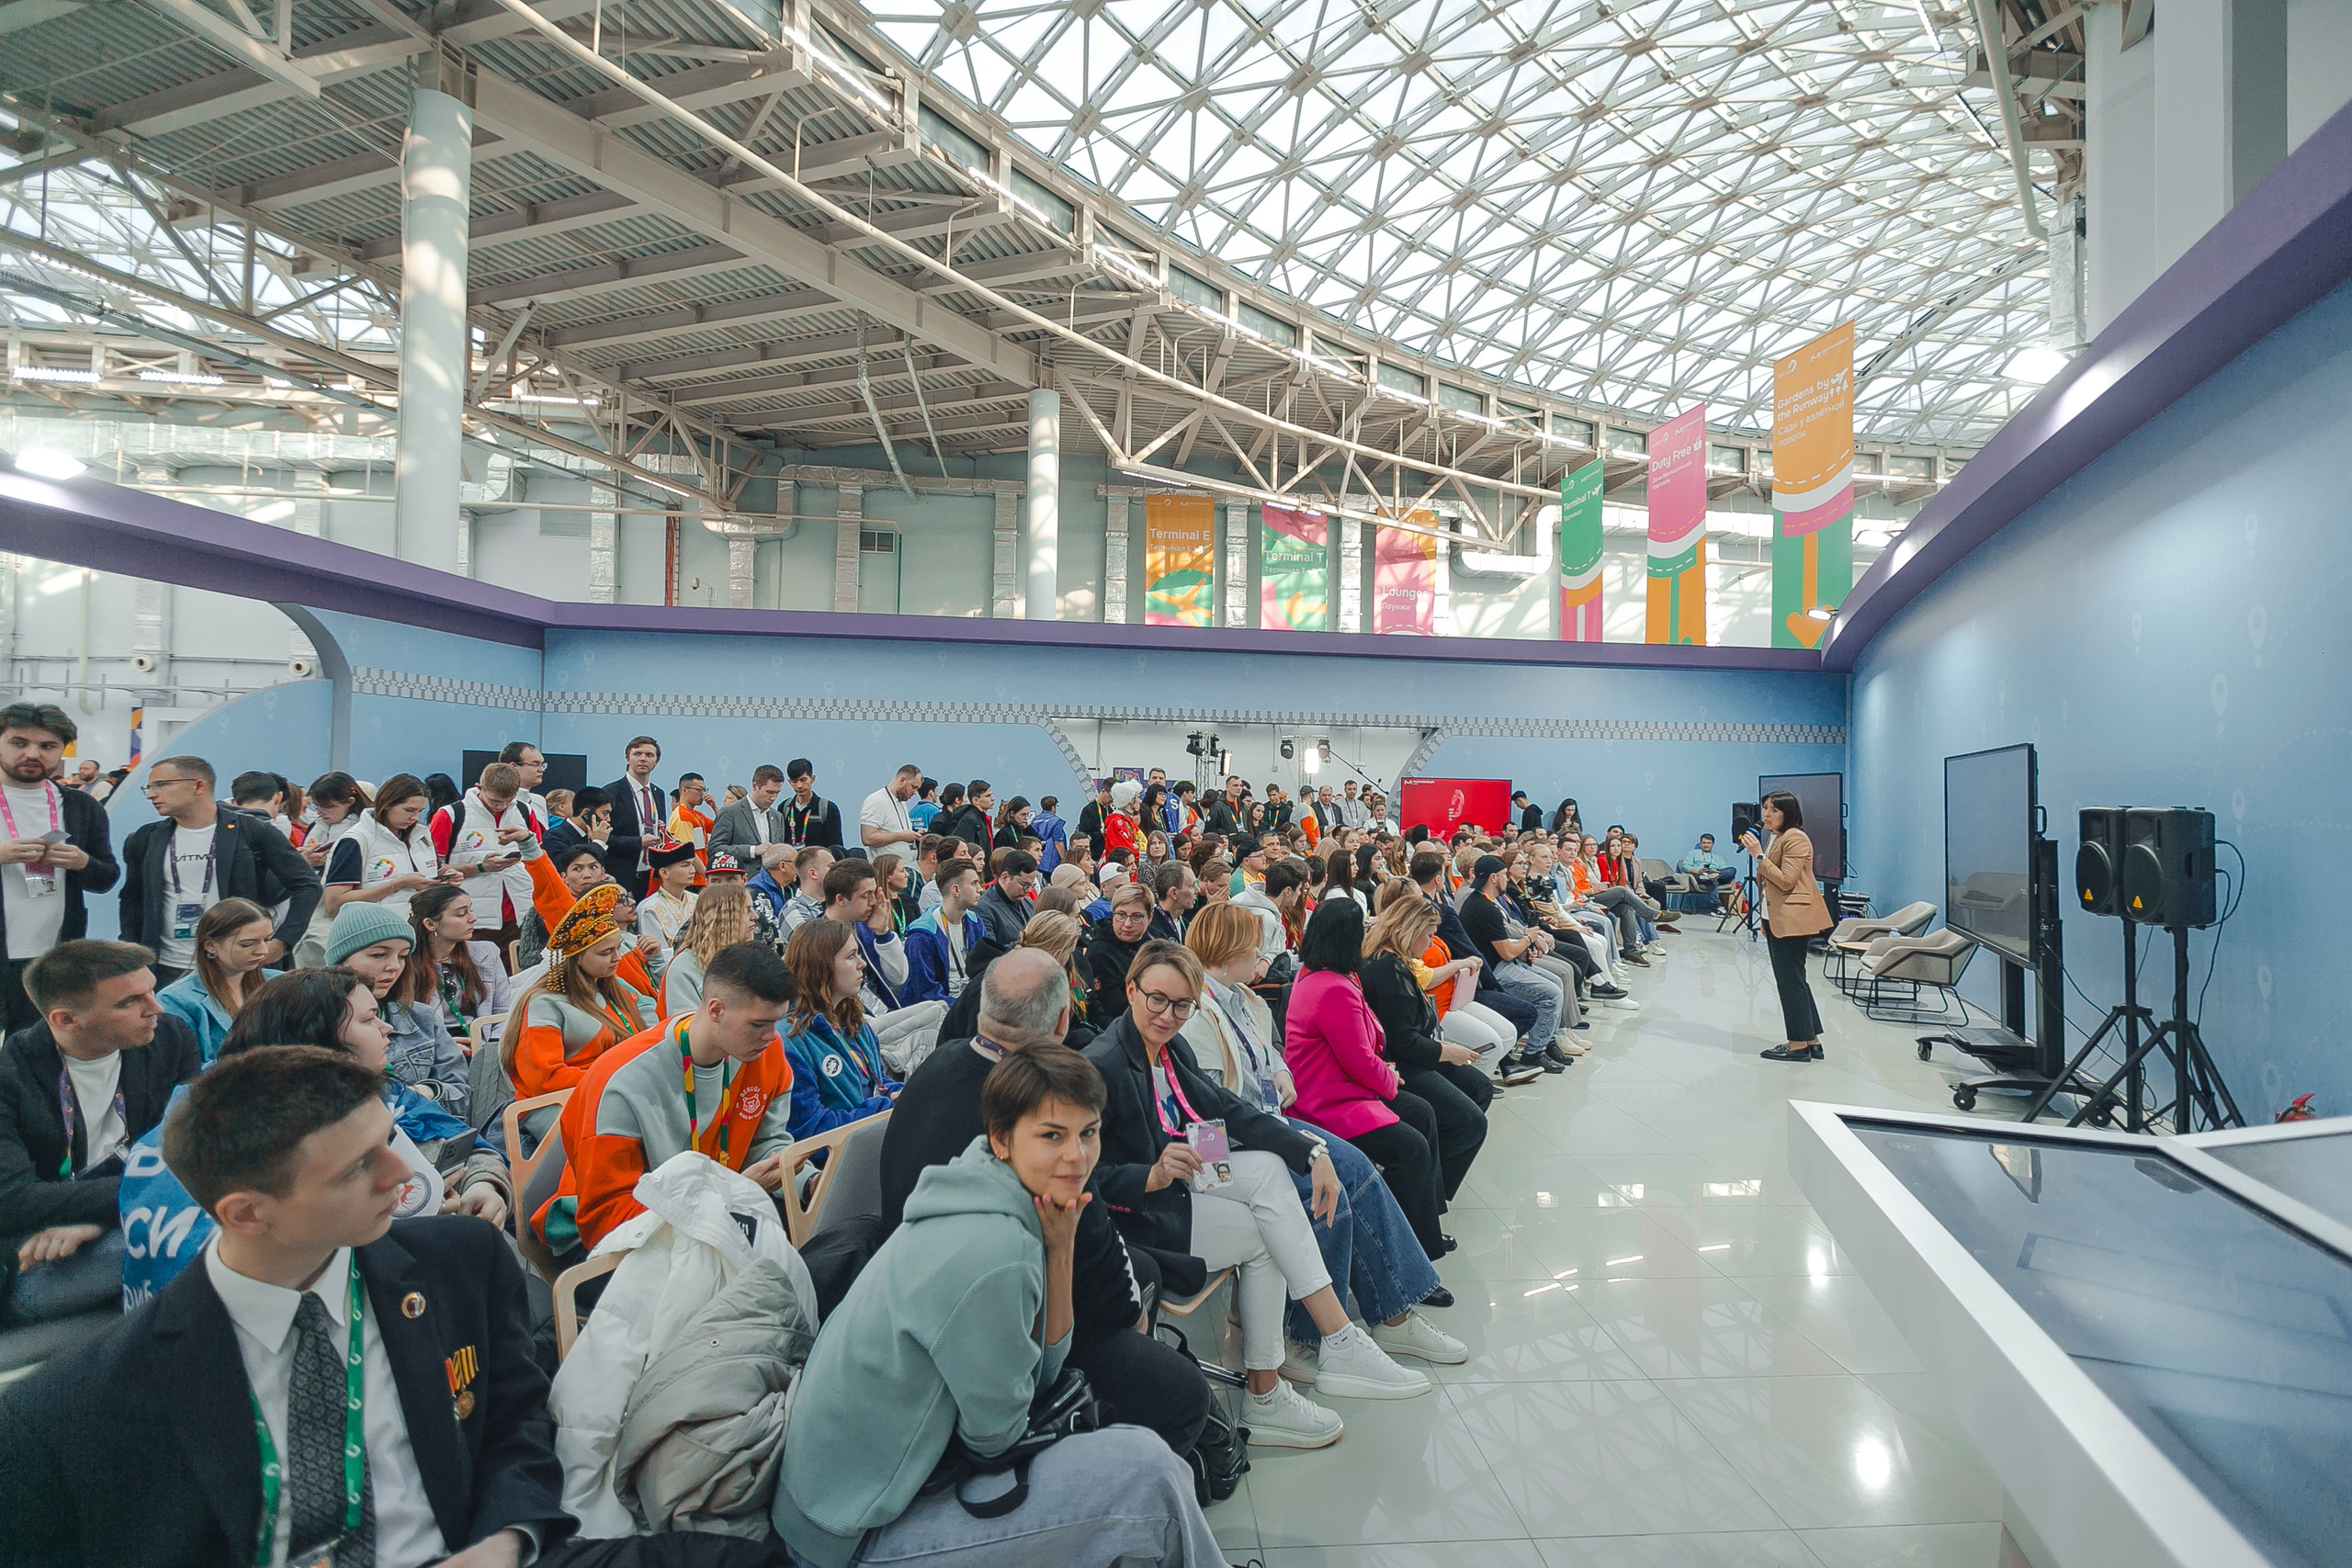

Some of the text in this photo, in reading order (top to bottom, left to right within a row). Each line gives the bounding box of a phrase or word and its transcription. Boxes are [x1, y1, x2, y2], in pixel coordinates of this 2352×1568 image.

[1777, 378, 1830, 410] Gardens by
[1777, 390, 1829, 422] the Runway
[1778, 399, 1845, 435] Сады у взлётной
[1778, 430, 1806, 447] полосы
[1652, 446, 1691, 472] Duty Free
[1563, 490, 1591, 512] Terminal T
[1149, 528, 1210, 541] Terminal E
[1149, 543, 1185, 552] Терминал
[1264, 549, 1324, 563] Terminal T
[1264, 565, 1300, 574] Терминал
[1381, 602, 1411, 612] Лаунжи
[1170, 798, 1179, 809] S
[740, 1086, 761, 1098] BEREGI
